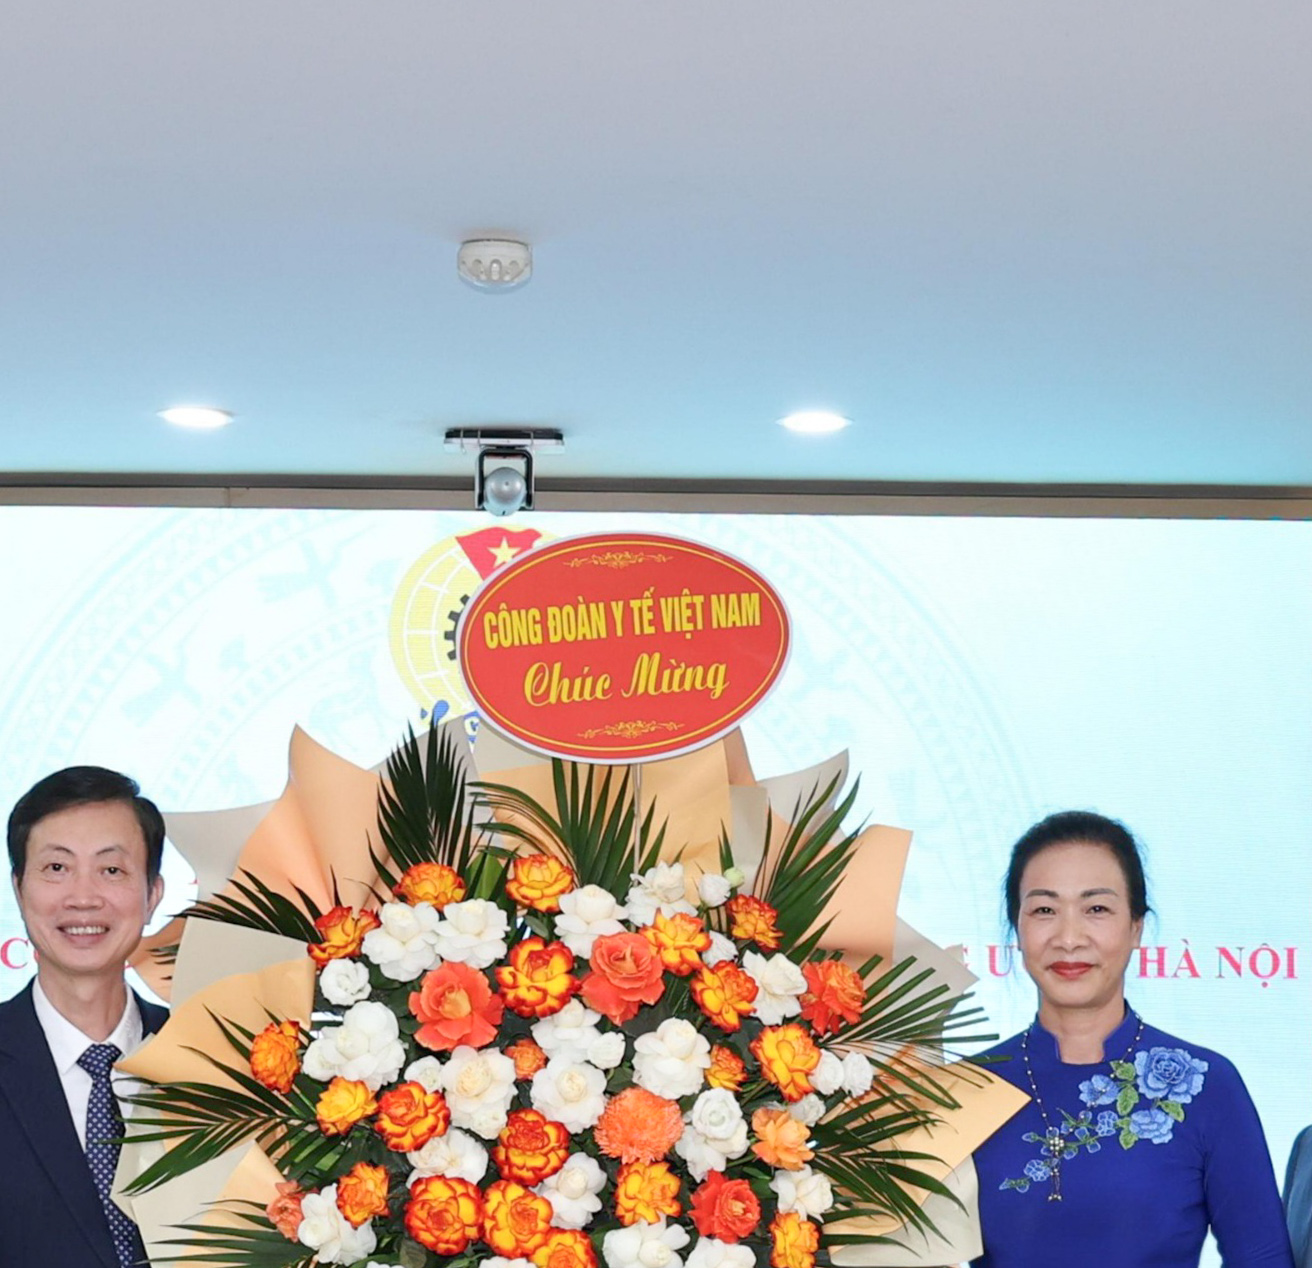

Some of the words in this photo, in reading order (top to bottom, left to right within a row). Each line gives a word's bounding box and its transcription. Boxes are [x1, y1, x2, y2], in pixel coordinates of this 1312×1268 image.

[483, 603, 543, 649] CÔNG
[547, 596, 607, 643] ĐOÀN
[611, 600, 624, 637] Y
[630, 587, 655, 635] TẾ
[660, 588, 704, 639] VIỆT
[710, 593, 761, 629] NAM
[523, 661, 613, 707] Chúc
[620, 652, 730, 699] Mừng
[1137, 939, 1201, 978] HÀ
[1215, 942, 1299, 988] NỘI
